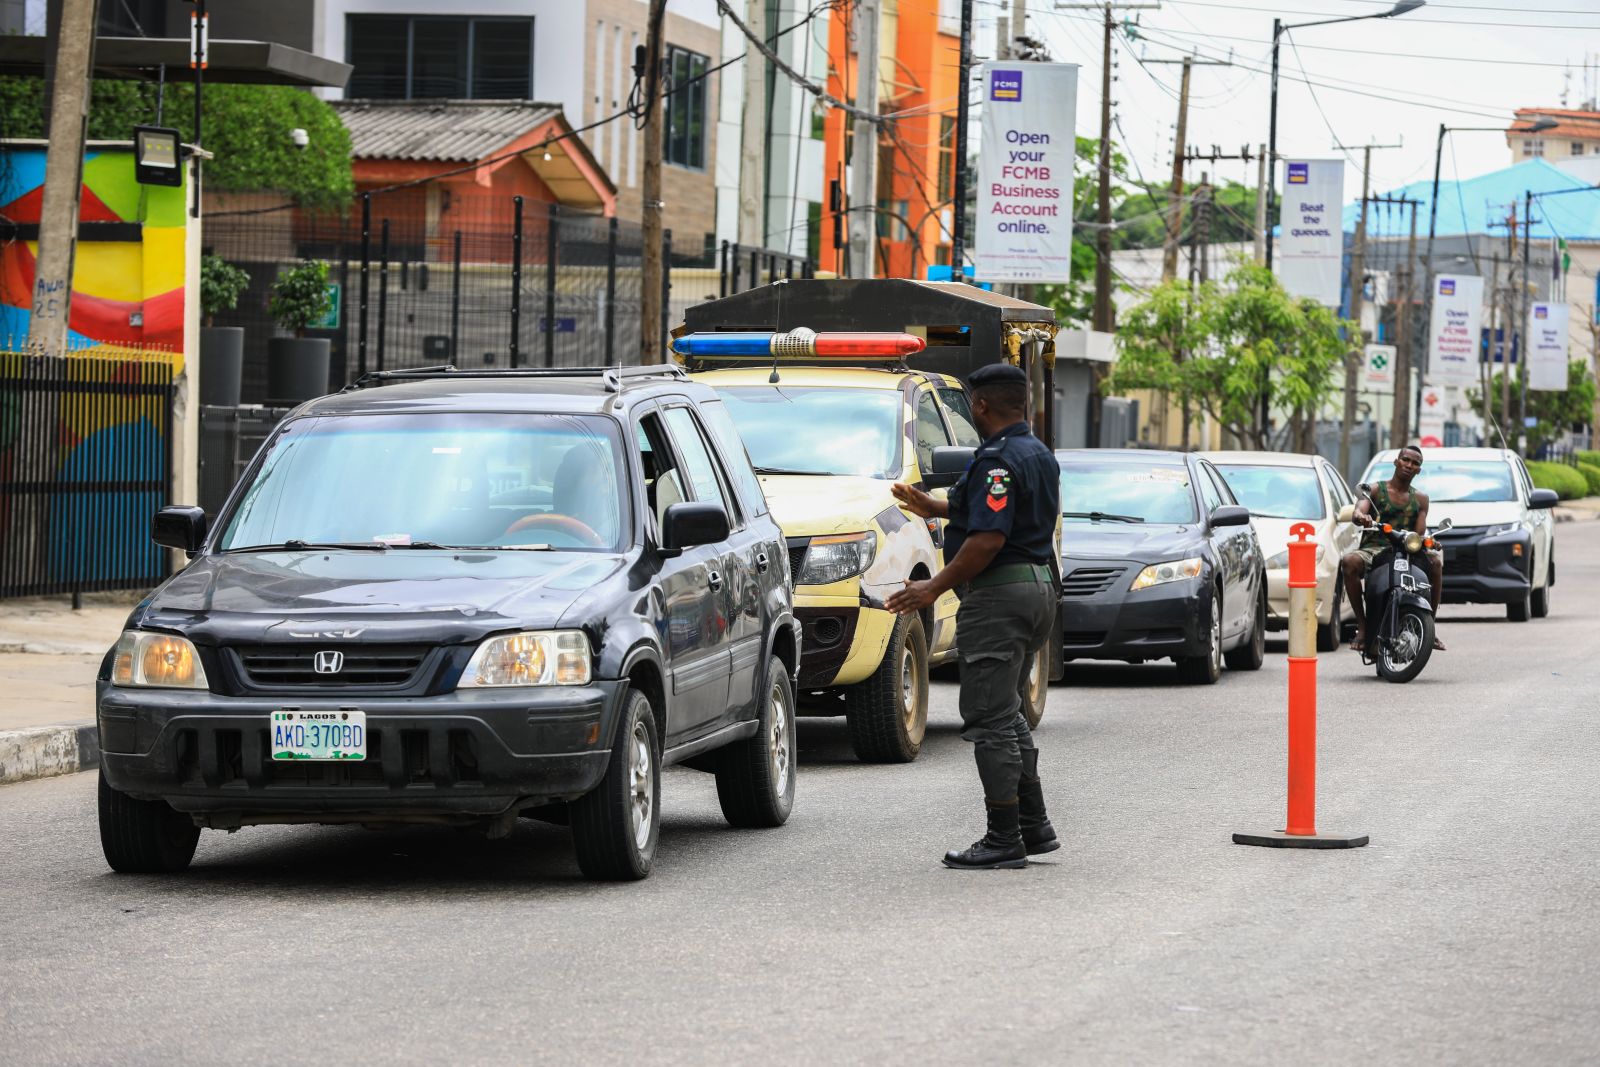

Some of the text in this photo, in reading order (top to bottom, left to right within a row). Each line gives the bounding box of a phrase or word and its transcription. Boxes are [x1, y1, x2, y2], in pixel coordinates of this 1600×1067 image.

[1006, 129, 1050, 146] Open
[1009, 150, 1045, 163] your
[1002, 166, 1050, 180] FCMB
[991, 183, 1060, 199] Business
[991, 201, 1058, 216] Account
[1300, 202, 1324, 212] Beat
[997, 219, 1050, 234] online.
[1303, 215, 1320, 224] the
[1291, 228, 1331, 237] queues.
[36, 299, 58, 318] 25
[275, 725, 363, 748] AKD-370BD
